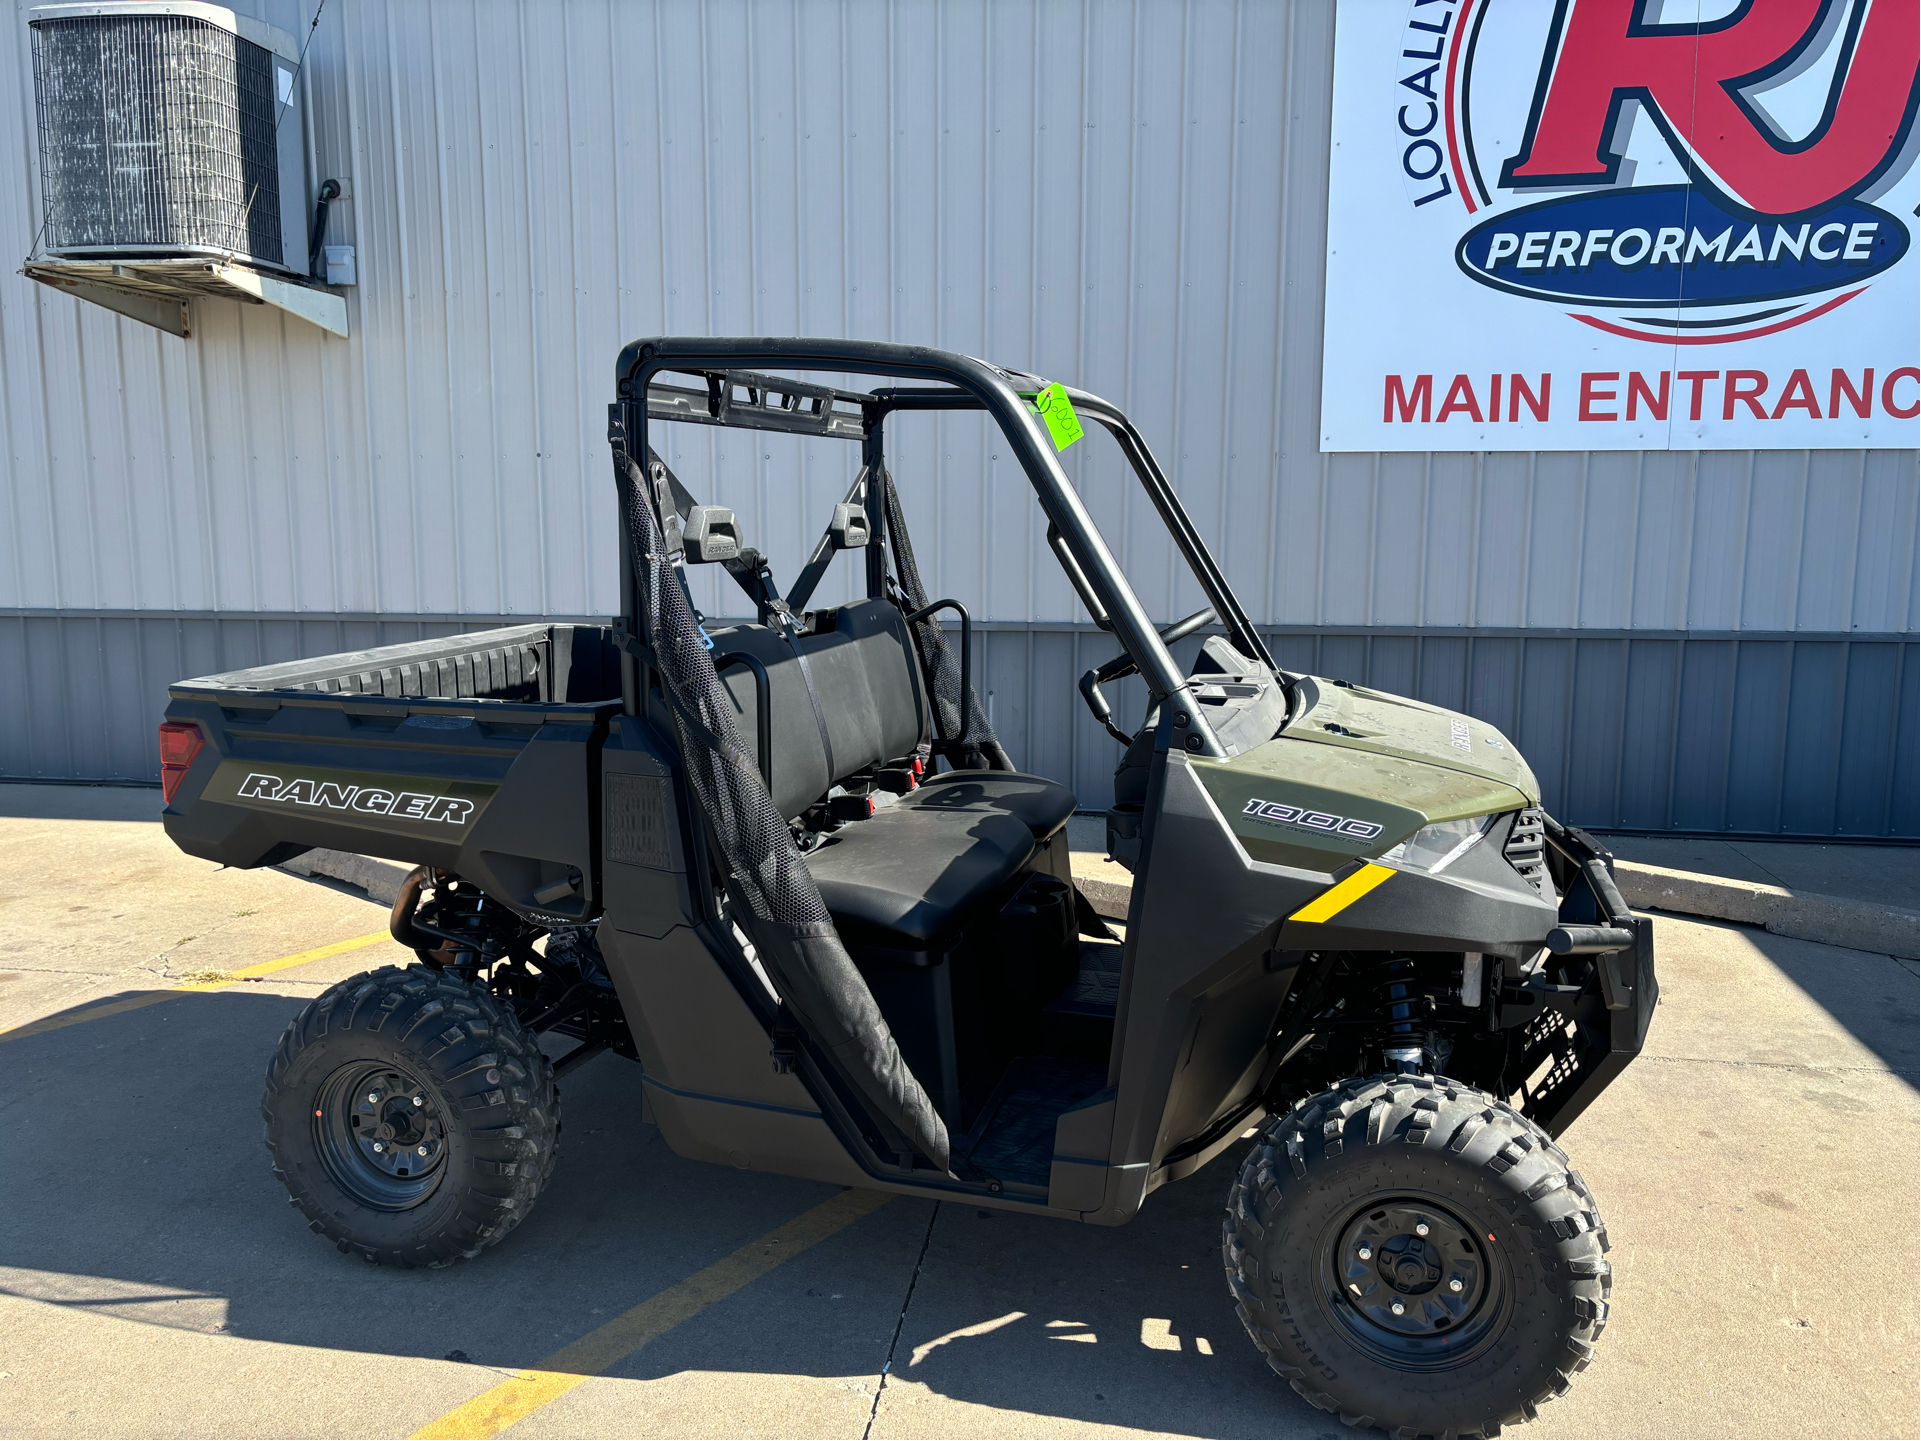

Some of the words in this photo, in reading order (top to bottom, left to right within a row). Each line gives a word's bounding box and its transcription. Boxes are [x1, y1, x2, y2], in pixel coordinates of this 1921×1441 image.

[1485, 222, 1880, 270] PERFORMANCE
[1382, 373, 1553, 424] MAIN
[1577, 366, 1921, 423] ENTRANC
[1450, 717, 1472, 753] RANGER
[237, 773, 475, 825] RANGER
[1242, 798, 1385, 841] 1000
[1285, 825, 1346, 843] OVERHEAD
[1347, 838, 1374, 848] CAM
[1271, 1270, 1339, 1381] CARLISLE
